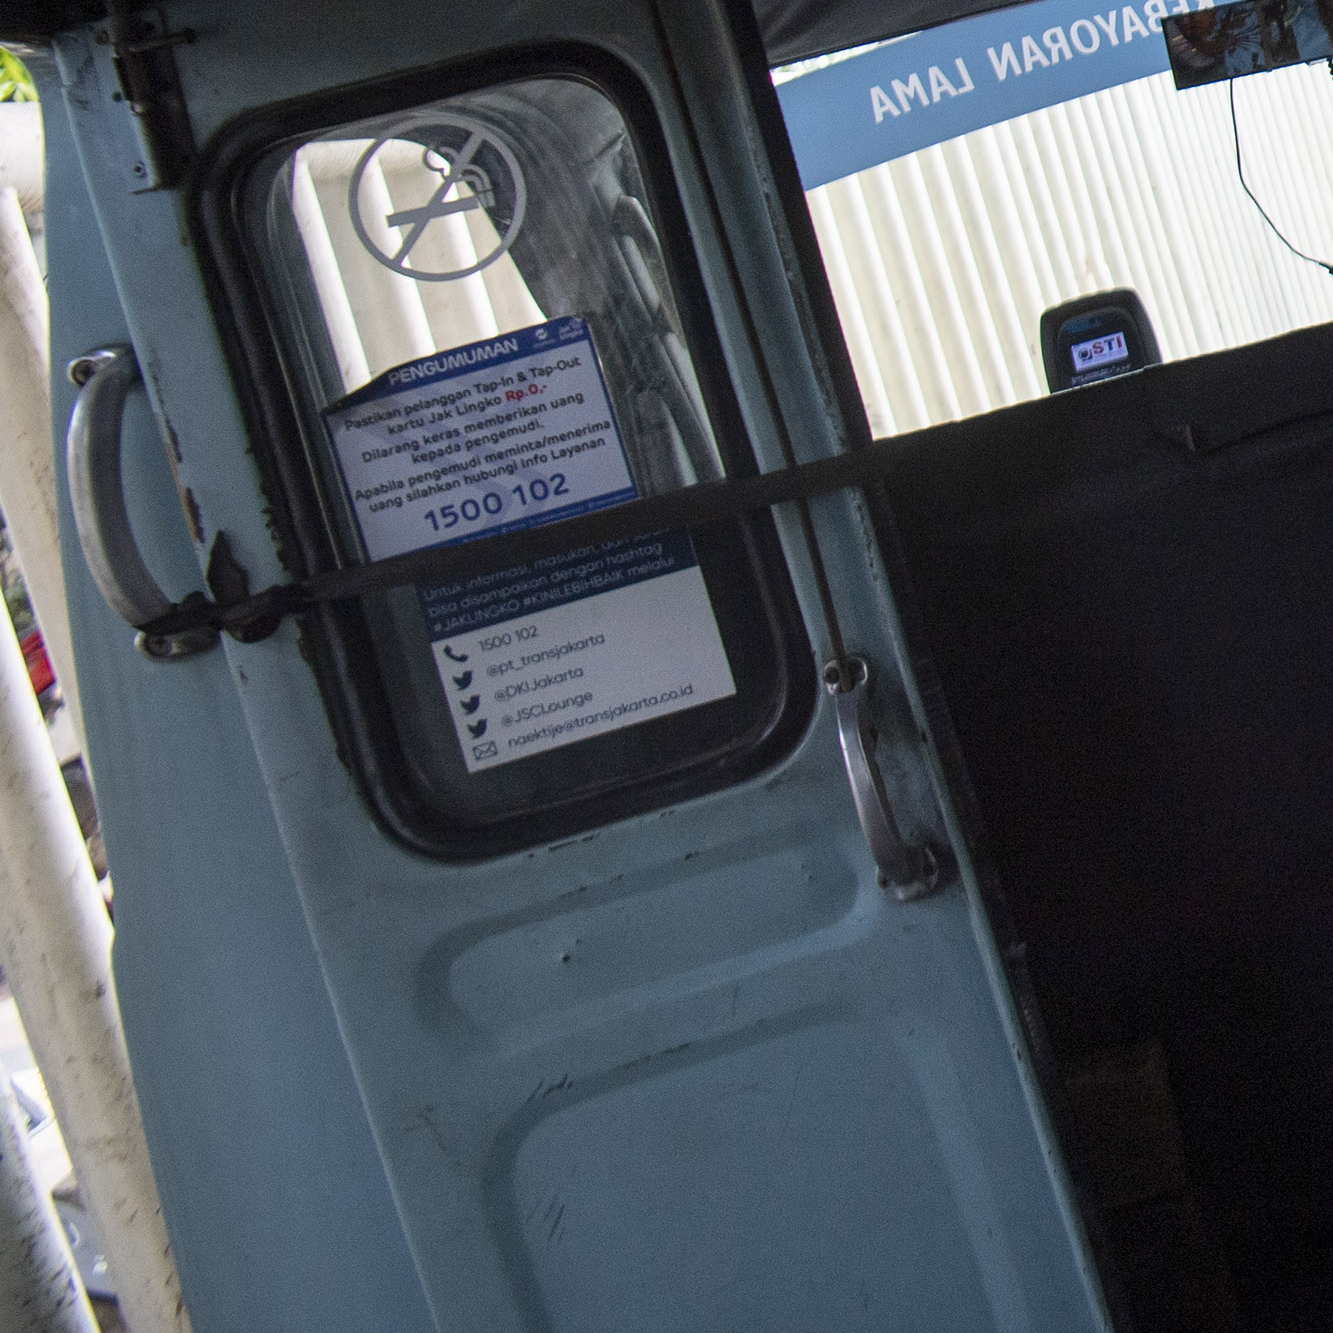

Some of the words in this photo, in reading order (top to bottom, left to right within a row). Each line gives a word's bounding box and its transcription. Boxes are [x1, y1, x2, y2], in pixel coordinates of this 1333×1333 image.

[387, 337, 520, 386] PENGUMUMAN
[344, 407, 401, 432] Pastikan
[404, 389, 472, 417] pelanggan
[473, 375, 514, 396] Tap-In
[516, 372, 528, 384] &
[529, 356, 582, 382] Tap-Out
[387, 415, 425, 436] kartu
[427, 407, 455, 425] Jak
[456, 394, 503, 419] Lingko
[361, 439, 420, 464] Dilarang
[422, 427, 461, 446] keras
[463, 402, 548, 435] memberikan
[550, 391, 584, 413] uang
[411, 441, 462, 465] kepada
[465, 418, 545, 452] pengemudi.
[354, 480, 405, 504] Apabila
[407, 456, 482, 489] pengemudi
[484, 418, 612, 466] meminta/menerima
[368, 493, 403, 514] uang
[405, 478, 461, 502] silahkan
[463, 461, 518, 486] hubungi
[521, 452, 548, 472] Info
[550, 436, 606, 462] Layanan
[423, 491, 503, 532] 1500
[511, 472, 570, 508] 102
[460, 576, 548, 610] disampaikan
[550, 562, 604, 584] dengan
[605, 542, 663, 570] hashtag
[627, 555, 676, 578] melalui
[478, 632, 512, 653] 1500
[515, 624, 539, 643] 102
[486, 632, 606, 678] @pt_transjakarta
[493, 666, 585, 702] @DKIJakarta
[500, 690, 594, 728] @JSCLounge
